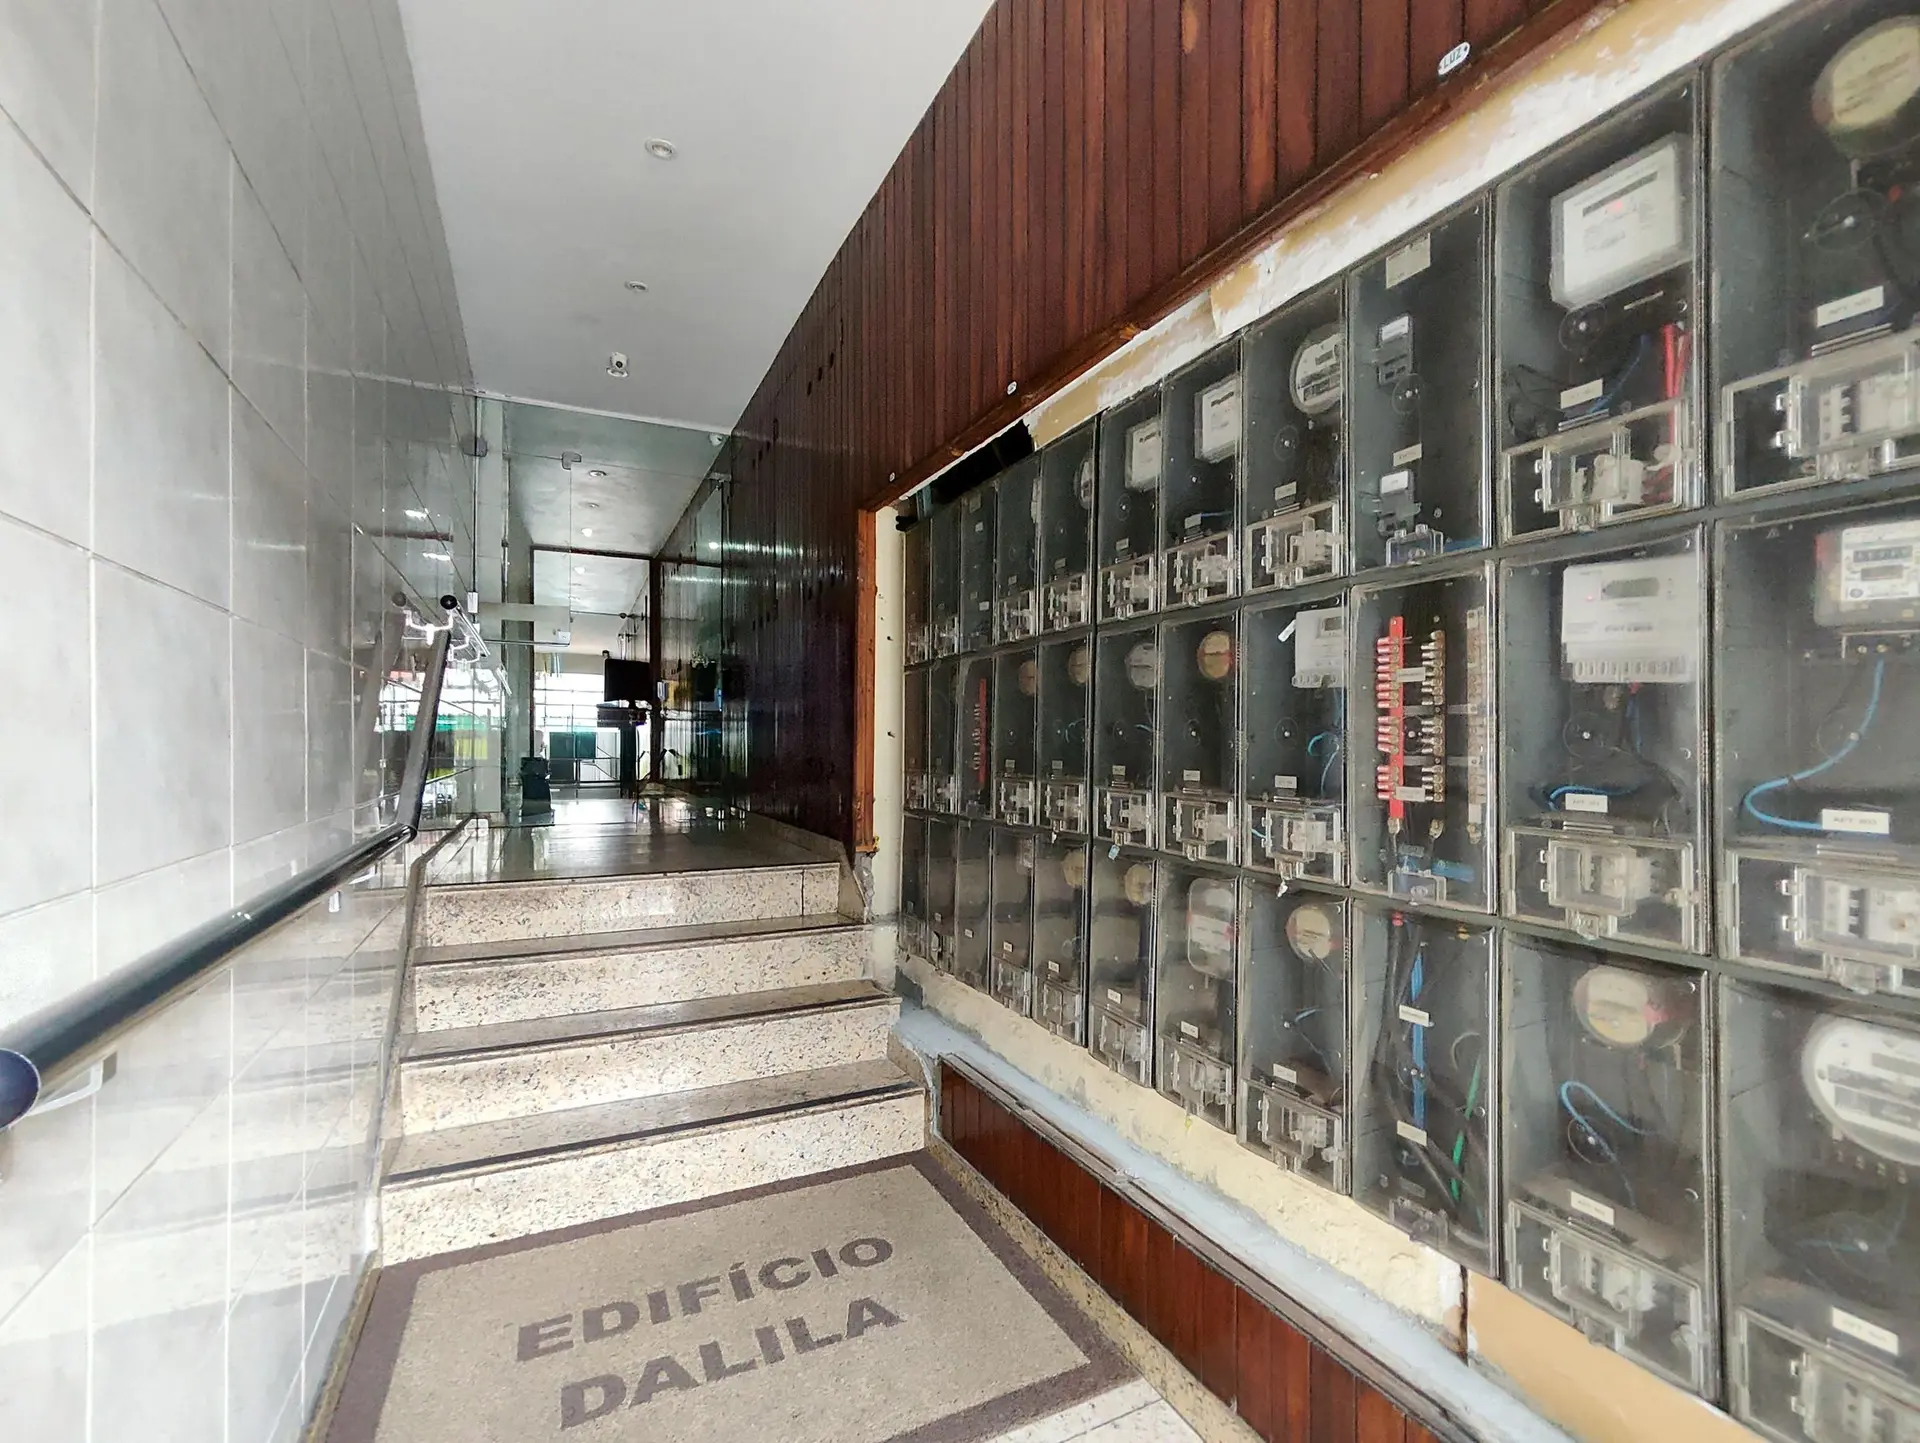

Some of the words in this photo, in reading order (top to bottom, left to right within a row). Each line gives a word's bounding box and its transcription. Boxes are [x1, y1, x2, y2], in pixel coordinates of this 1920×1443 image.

[1443, 46, 1461, 69] LUZ
[516, 1236, 893, 1362] EDIFÍCIO
[560, 1297, 906, 1431] DALILA
